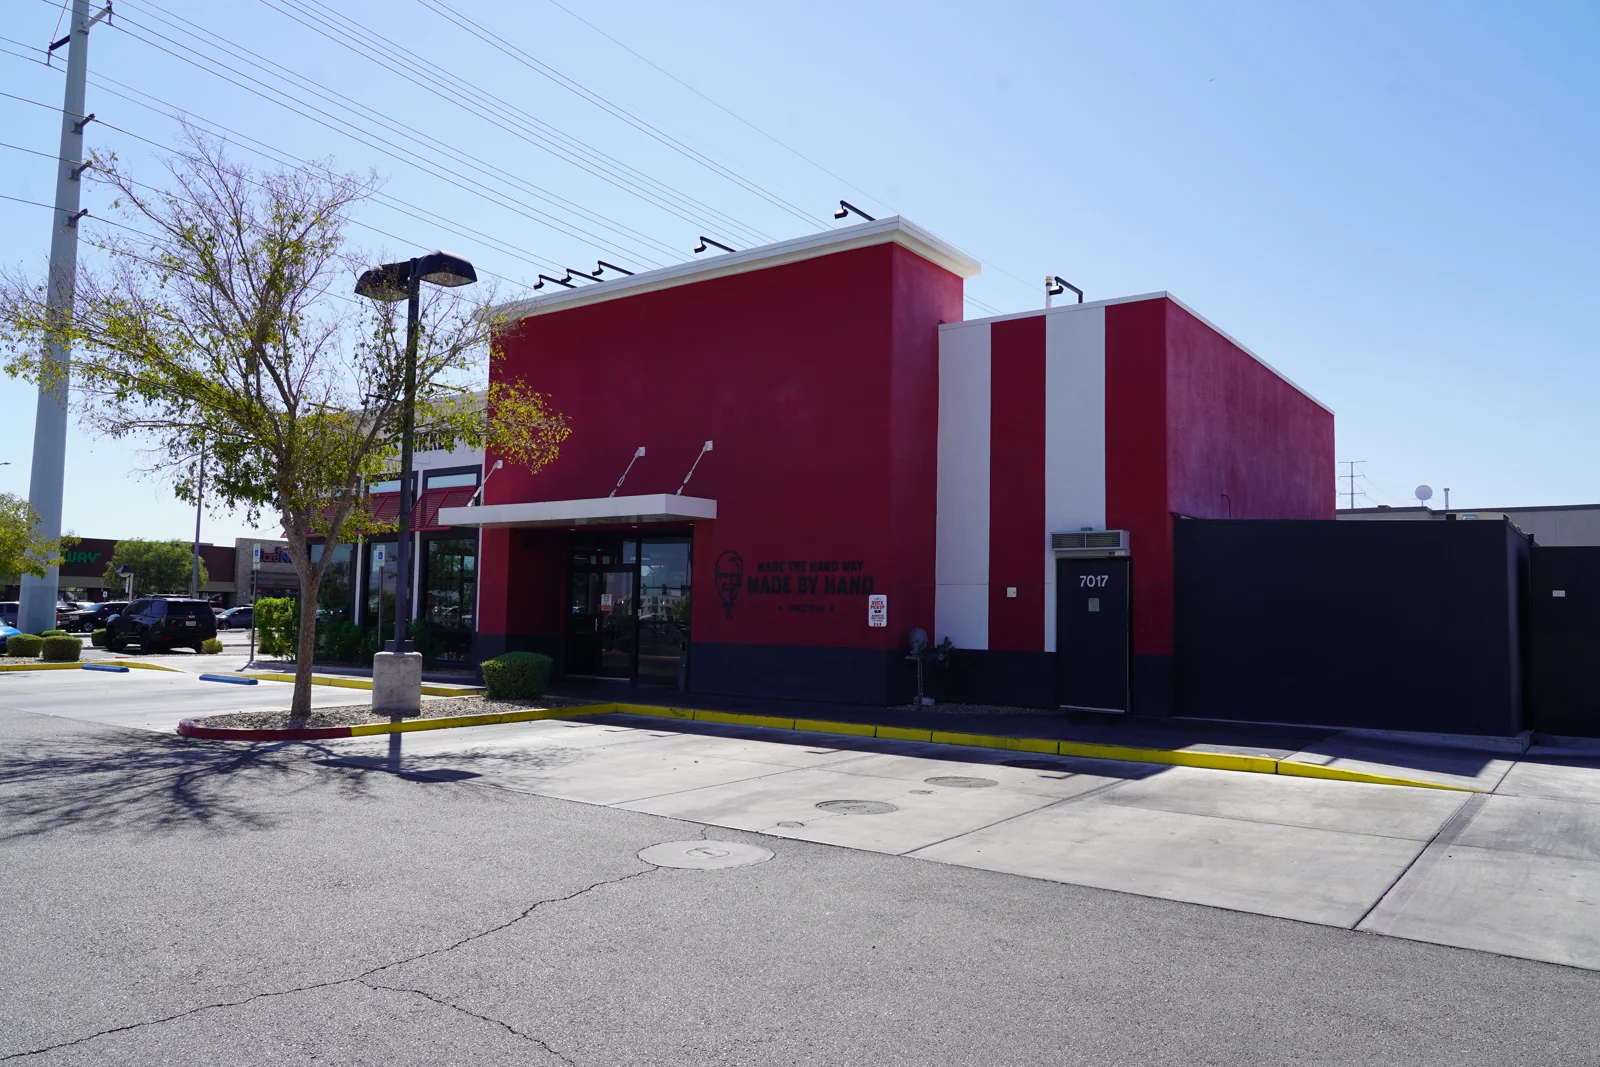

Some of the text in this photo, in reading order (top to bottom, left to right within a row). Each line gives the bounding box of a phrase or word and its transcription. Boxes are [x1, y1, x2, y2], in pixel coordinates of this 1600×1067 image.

[758, 561, 864, 573] MADE THE HARD WAY
[748, 576, 874, 596] MADE BY HAND
[1080, 575, 1108, 587] 7017
